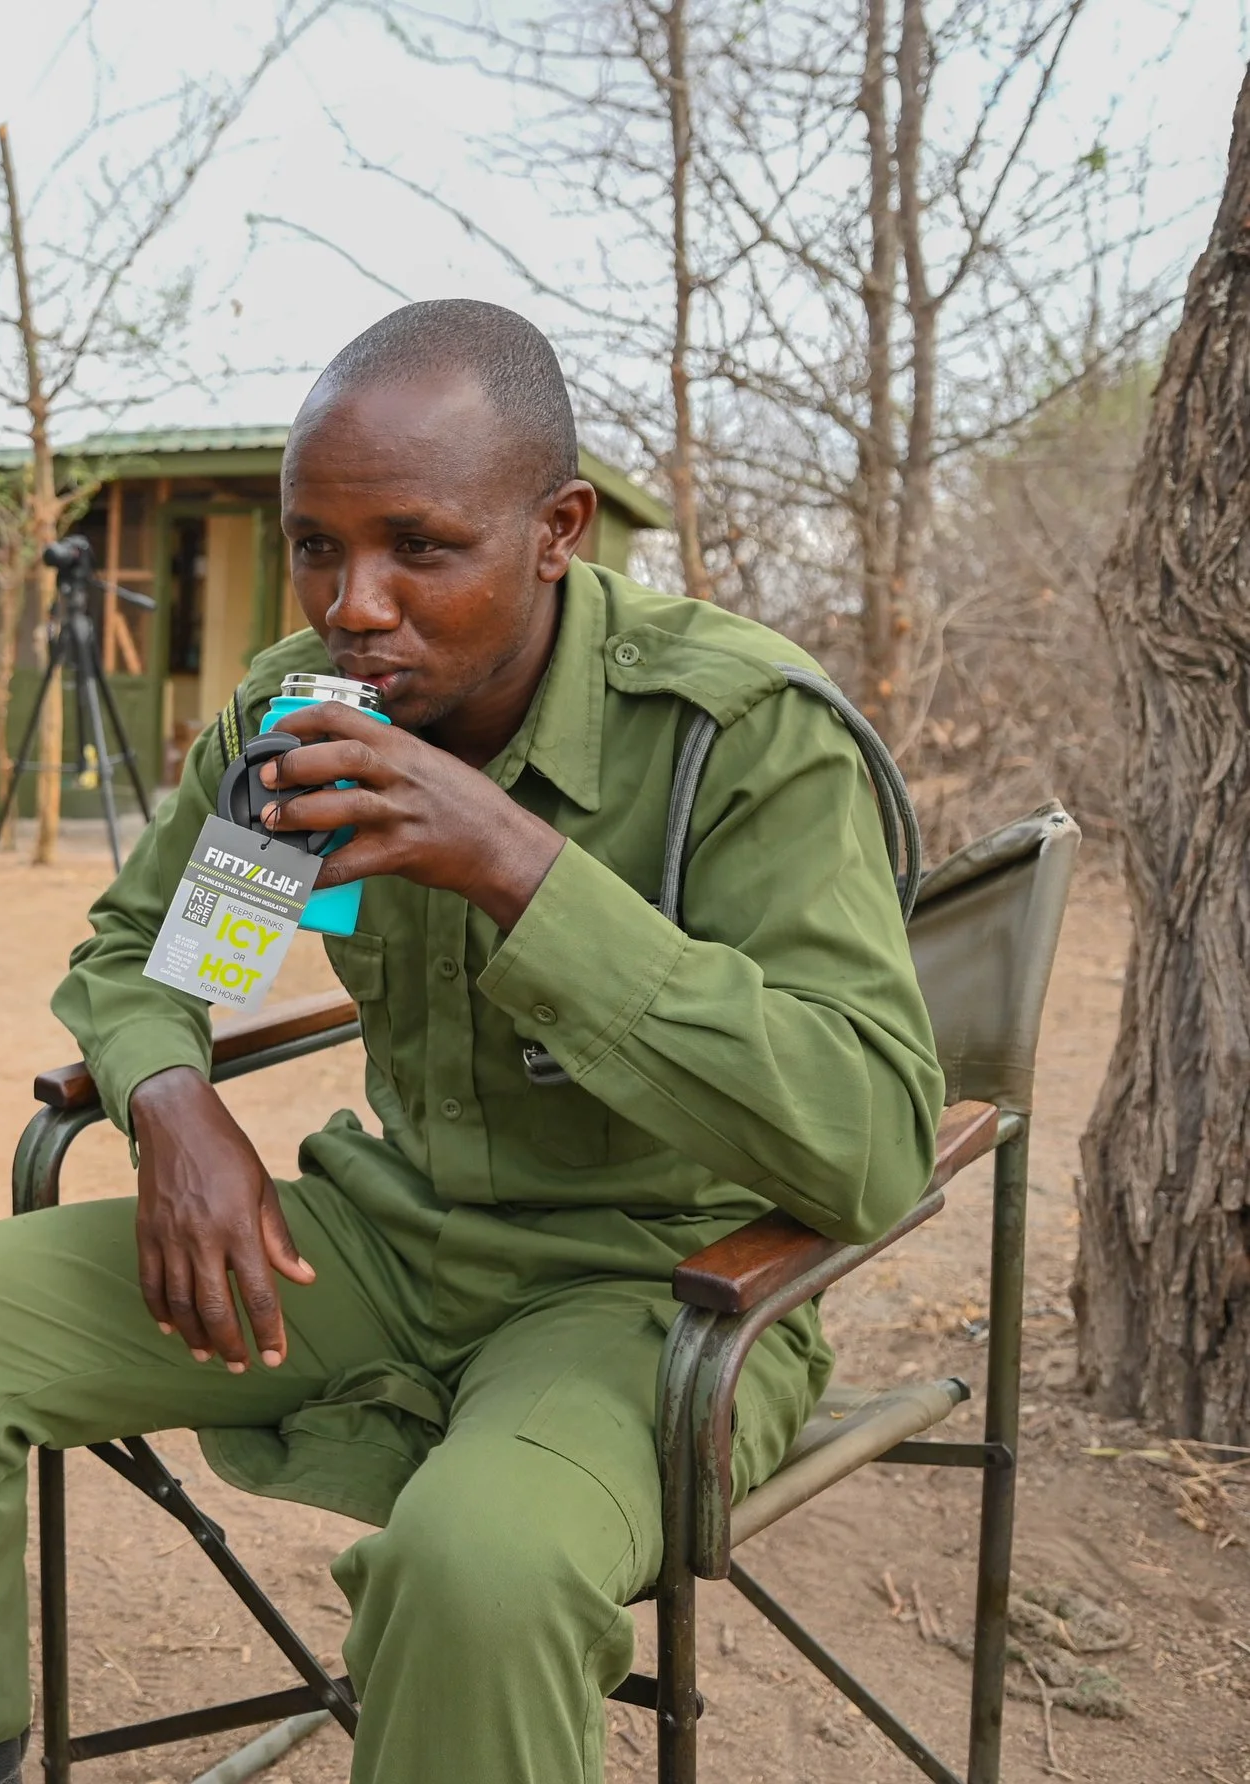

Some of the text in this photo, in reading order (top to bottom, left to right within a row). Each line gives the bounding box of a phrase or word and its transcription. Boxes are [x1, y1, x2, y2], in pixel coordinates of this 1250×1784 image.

[191, 887, 218, 908] RE
[197, 874, 288, 914] STAINLESS STEEL VACUUM INSULATED
[184, 911, 208, 925] ABLE
[188, 901, 212, 918] USE
[226, 903, 284, 931] KEEPS DRINKS
[215, 912, 282, 956] ICY
[233, 952, 246, 961] OR
[197, 953, 263, 994] HOT
[200, 982, 247, 1004] FOR HOURS
